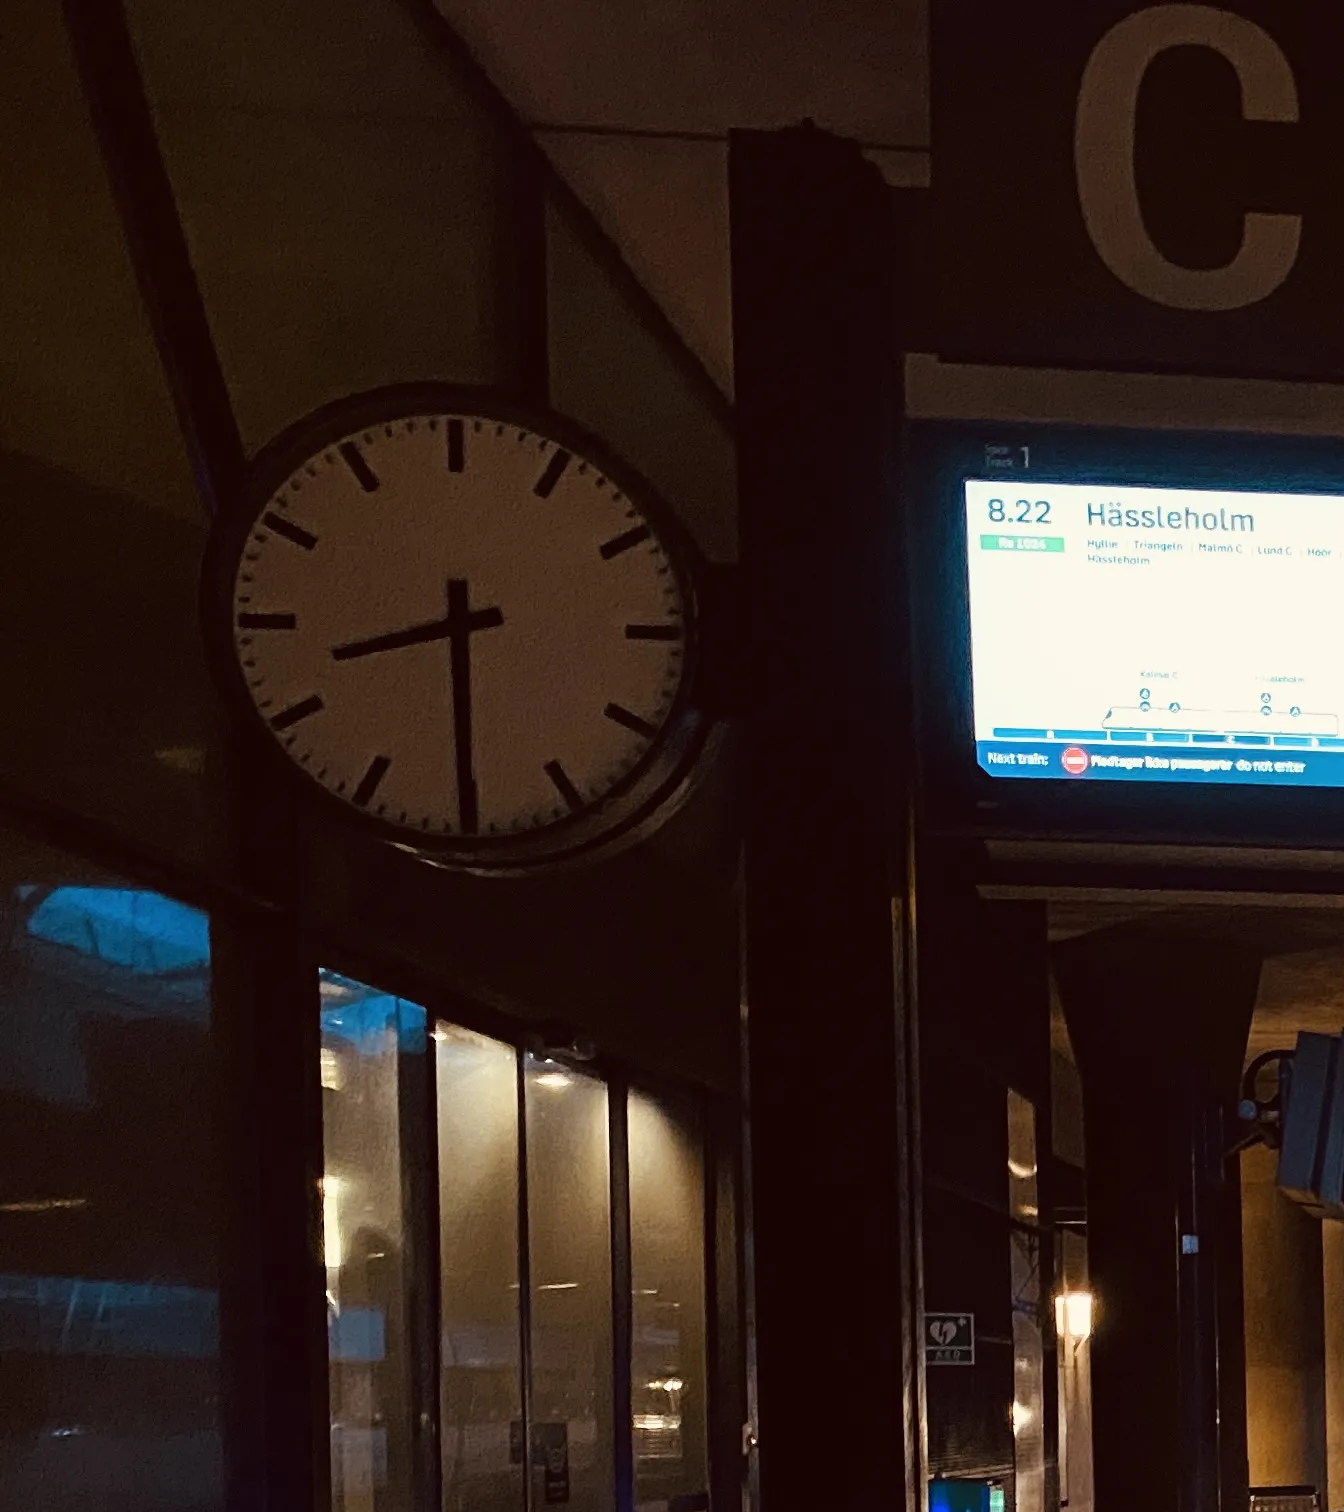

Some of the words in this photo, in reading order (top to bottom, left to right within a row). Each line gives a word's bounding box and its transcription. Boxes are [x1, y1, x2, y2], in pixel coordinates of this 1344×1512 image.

[1075, 4, 1302, 311] C
[987, 498, 1052, 525] 8.22
[1087, 502, 1255, 532] Hässleholm
[1087, 540, 1118, 550] Hyllie
[1134, 540, 1183, 552] Triangeln
[1198, 542, 1234, 553] Malmö
[1257, 545, 1284, 555] Lund
[1087, 554, 1151, 565] Hässleholm
[987, 752, 1015, 765] Next
[1274, 761, 1306, 773] enter
